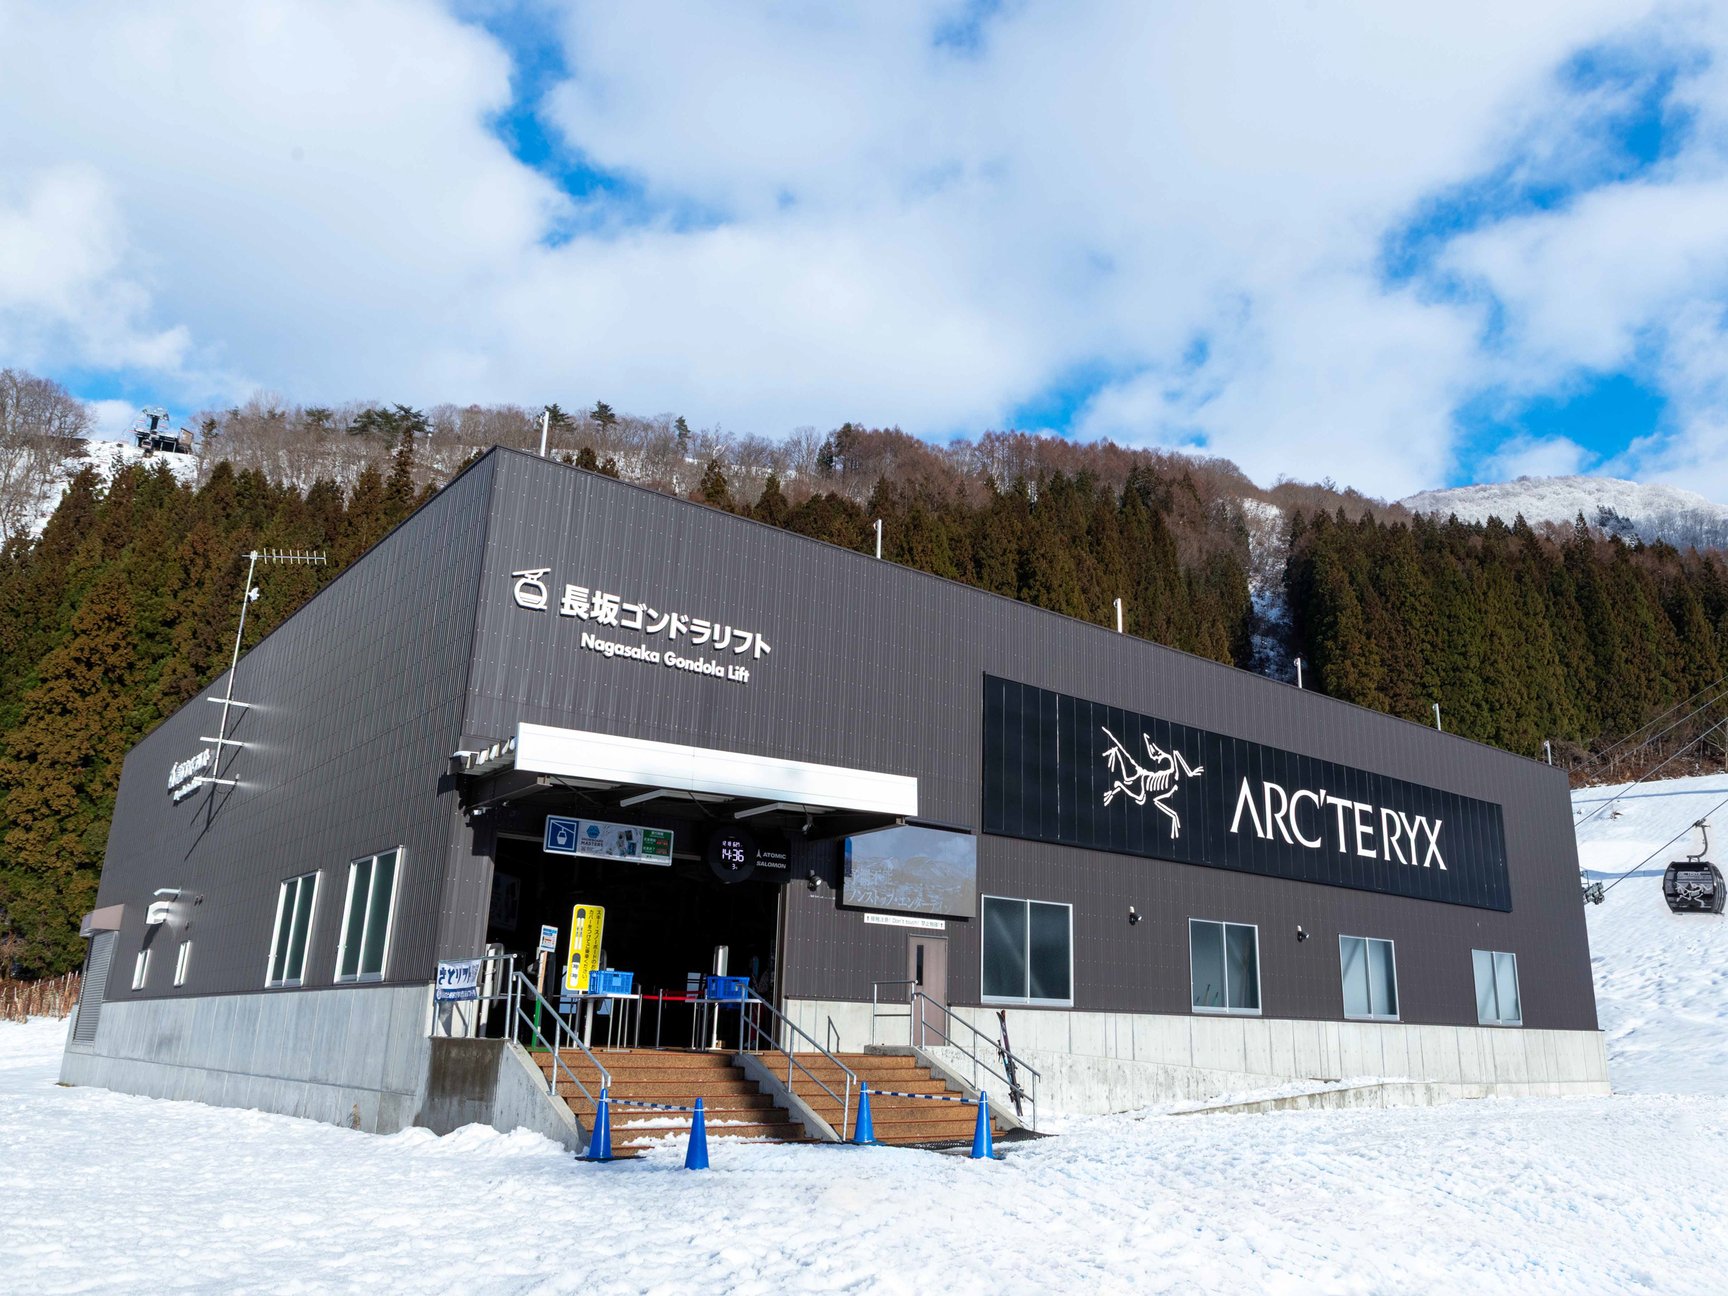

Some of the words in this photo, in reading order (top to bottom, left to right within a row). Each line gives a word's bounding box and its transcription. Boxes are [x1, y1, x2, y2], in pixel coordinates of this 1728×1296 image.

[560, 583, 771, 659] 長坂ゴンドラリフト
[580, 632, 660, 664] Nagasaka
[663, 650, 725, 678] Gondola
[727, 665, 750, 683] Lift
[1230, 775, 1448, 871] ARC'TERYX
[756, 861, 787, 869] SALOMON
[762, 852, 787, 860] ATOMIC
